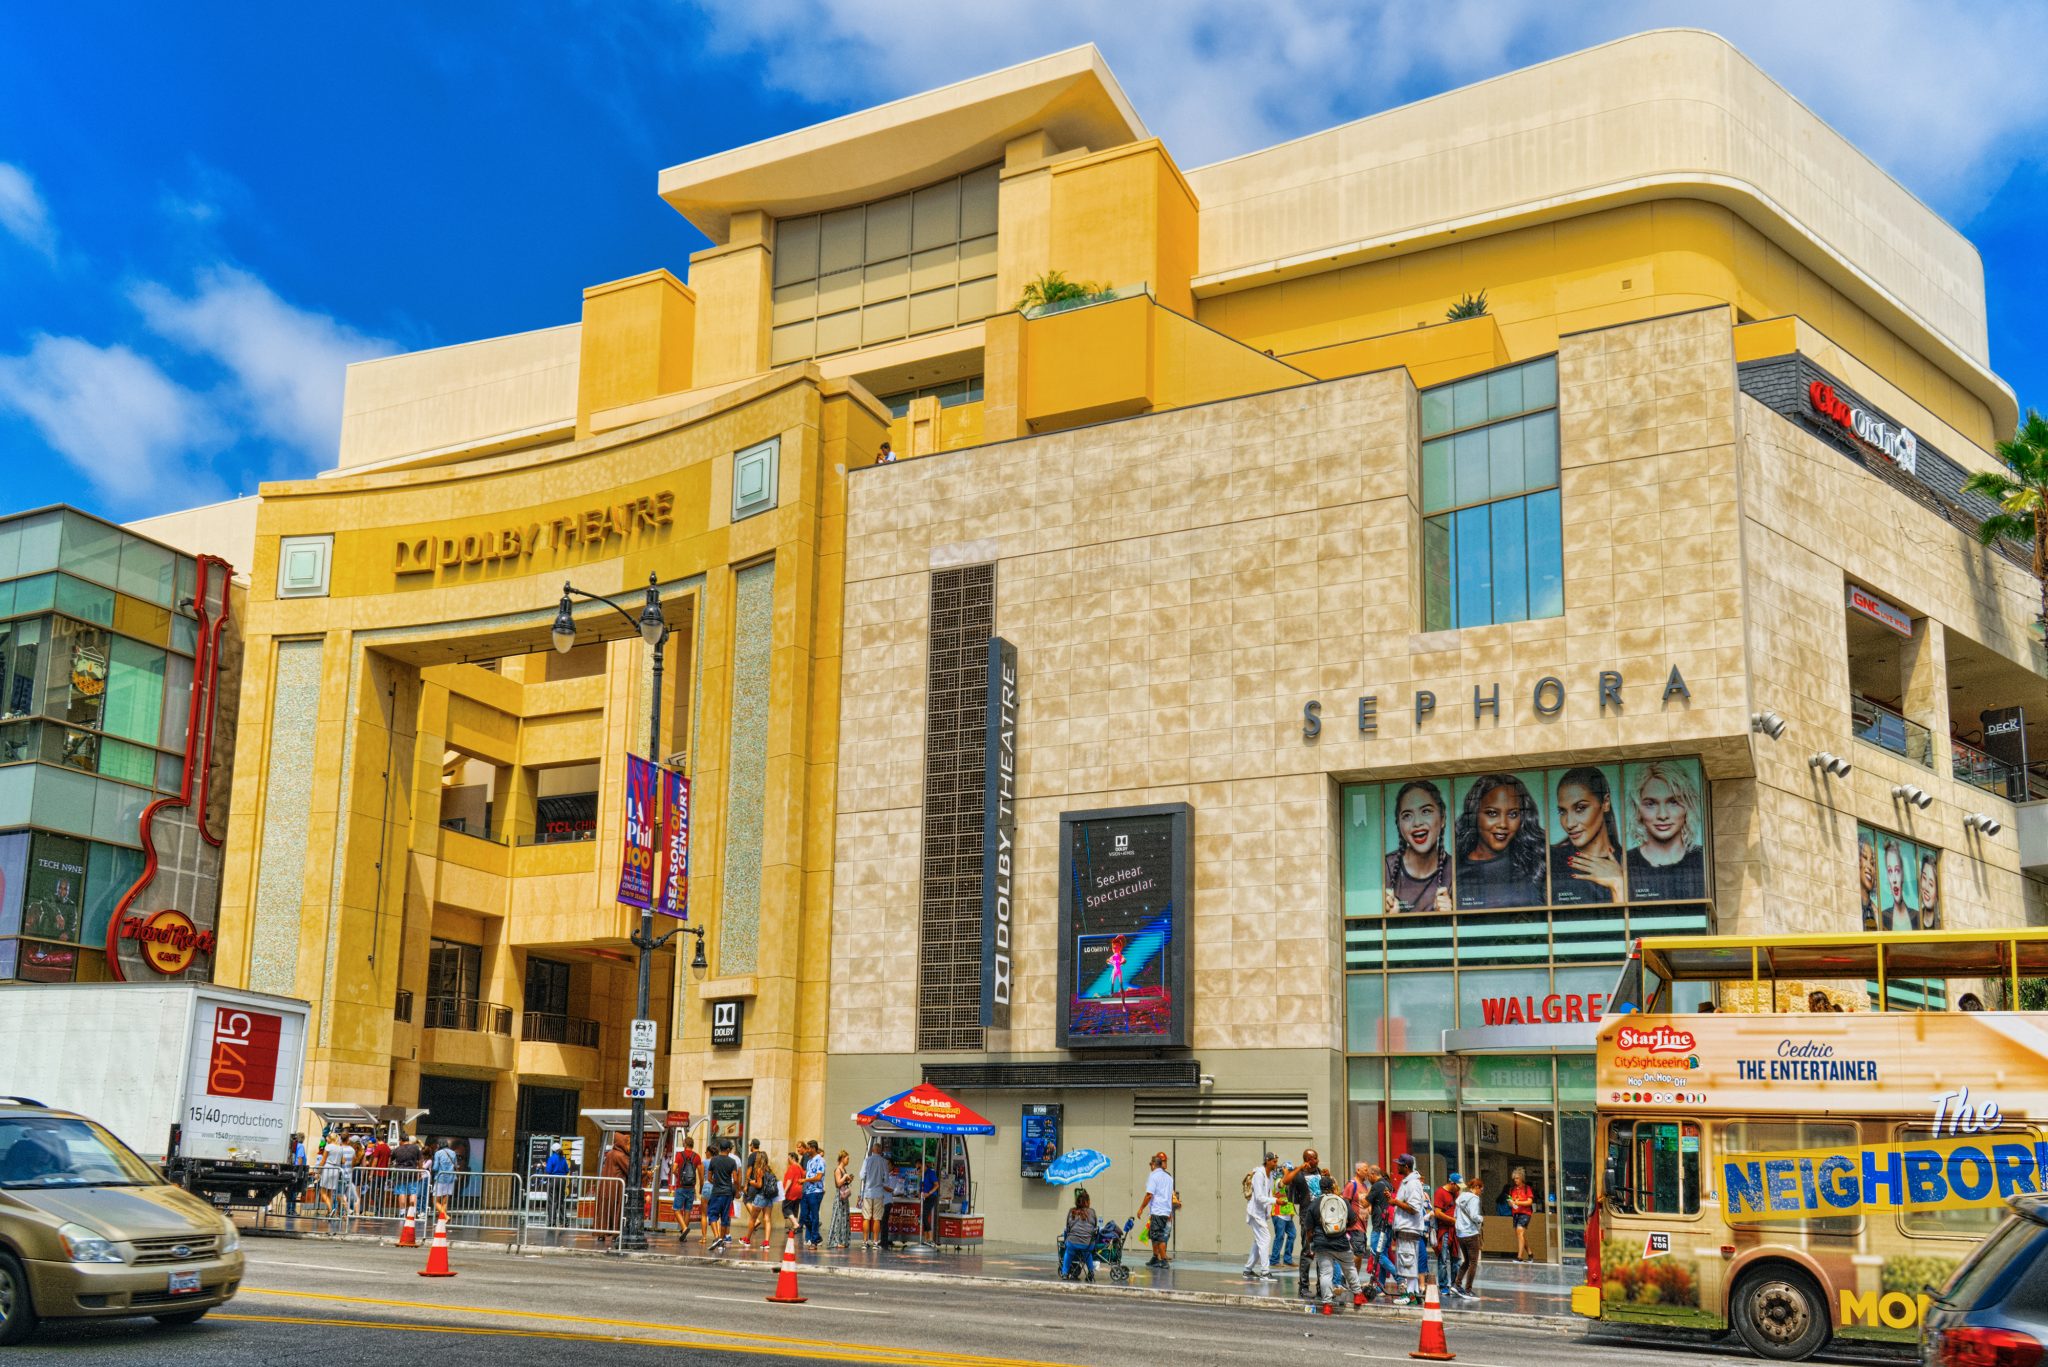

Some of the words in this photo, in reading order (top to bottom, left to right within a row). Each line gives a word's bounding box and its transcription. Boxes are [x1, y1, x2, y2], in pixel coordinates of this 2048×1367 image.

[438, 522, 540, 567] DOLBY
[550, 490, 675, 551] THEATRE
[1854, 591, 1880, 616] GNC
[1302, 663, 1692, 738] SEPHORA
[1988, 720, 2018, 733] DECK
[1000, 663, 1015, 819] THEATRE
[627, 797, 645, 822] LA
[671, 803, 680, 832] OF
[546, 821, 572, 833] TCL
[626, 821, 653, 849] Phil
[679, 782, 689, 870] CENTURY
[39, 858, 59, 870] TECH
[62, 863, 83, 874] N9NE
[626, 846, 650, 870] 100
[667, 835, 680, 911] SEASON
[676, 875, 688, 911] THE
[997, 829, 1011, 948] DOLBY
[1086, 878, 1157, 908] Spectacular.
[120, 917, 175, 945] Hard
[170, 924, 217, 955] Rock
[1481, 993, 1613, 1026] WALGRE
[714, 1027, 735, 1037] DOLBY
[1777, 1039, 1834, 1058] Cedric
[1614, 1056, 1690, 1070] CitySightseeing
[1737, 1061, 1766, 1081] THE
[1771, 1060, 1878, 1082] ENTERTAINER
[221, 1111, 284, 1129] productions
[1928, 1086, 2004, 1139] The
